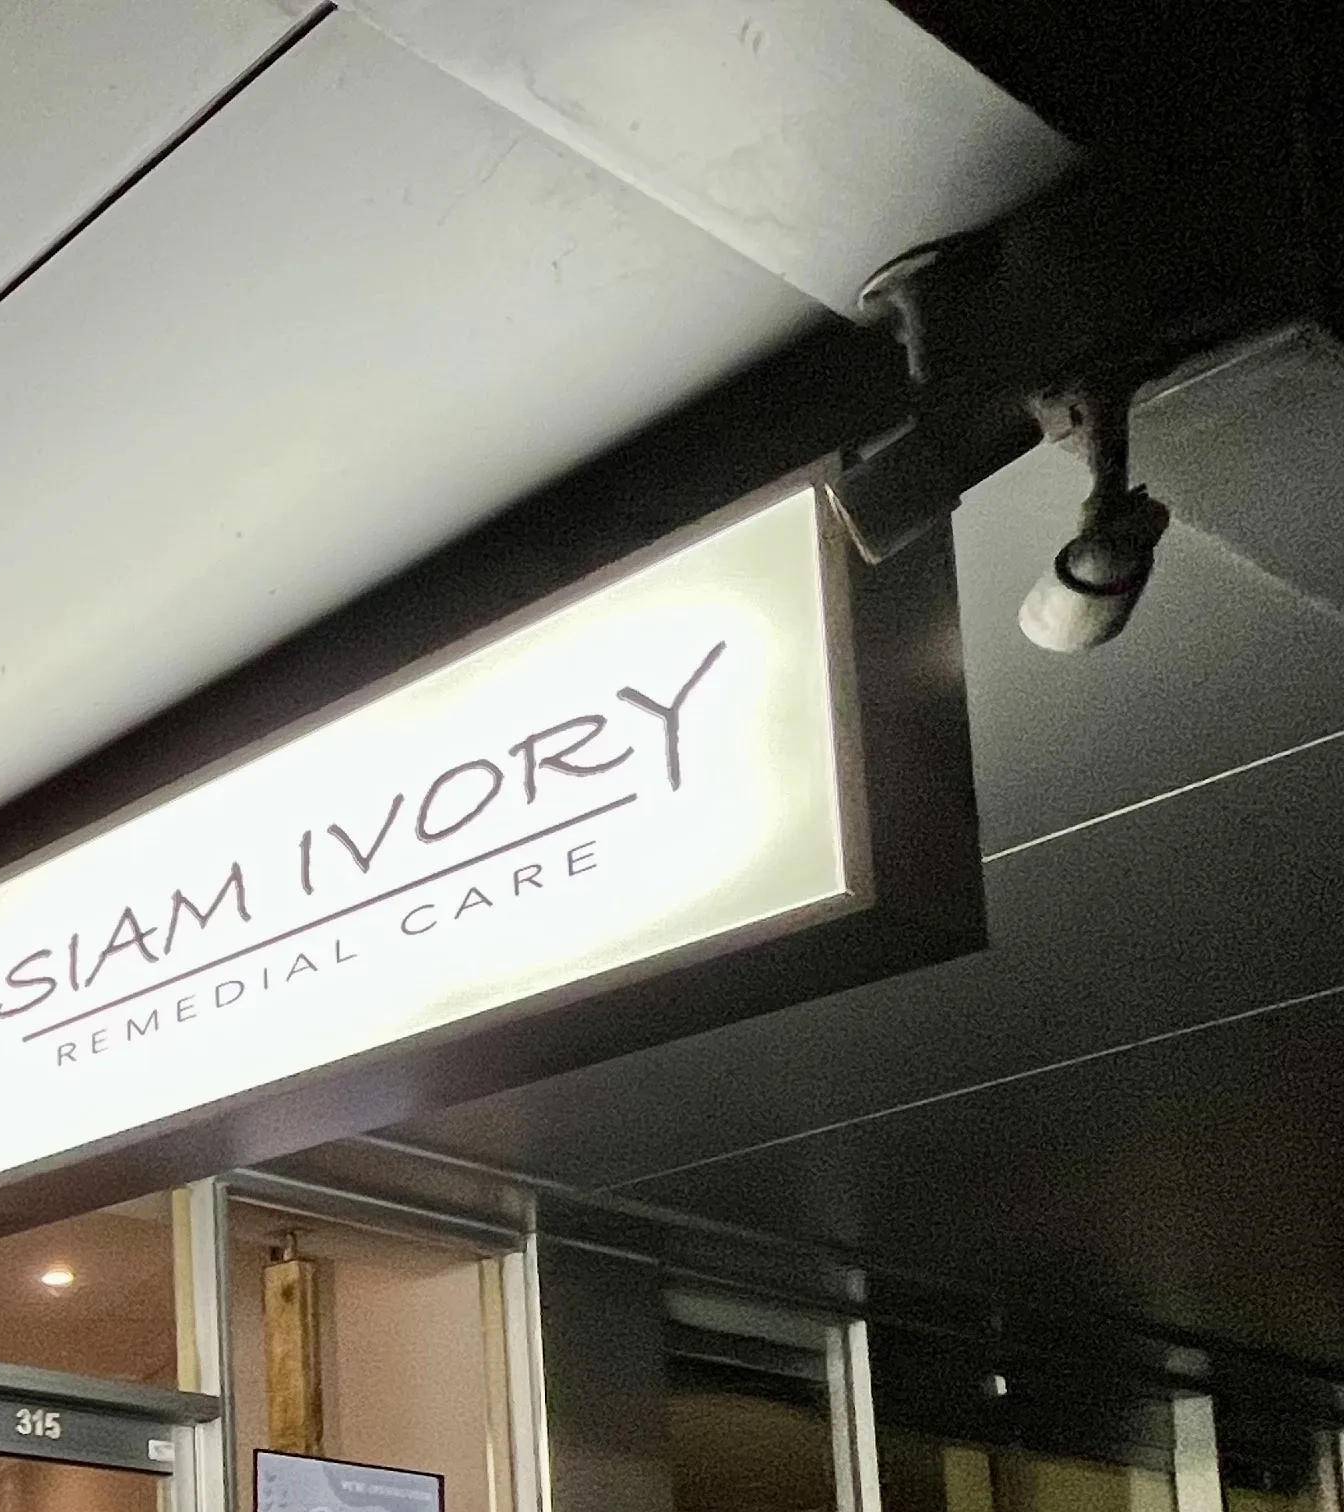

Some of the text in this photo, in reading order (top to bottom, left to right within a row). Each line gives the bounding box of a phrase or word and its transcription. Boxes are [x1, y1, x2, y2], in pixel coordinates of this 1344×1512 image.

[300, 640, 726, 896] IVORY
[56, 840, 598, 1068] REMEDIAL CARE
[14, 1408, 62, 1440] 315
